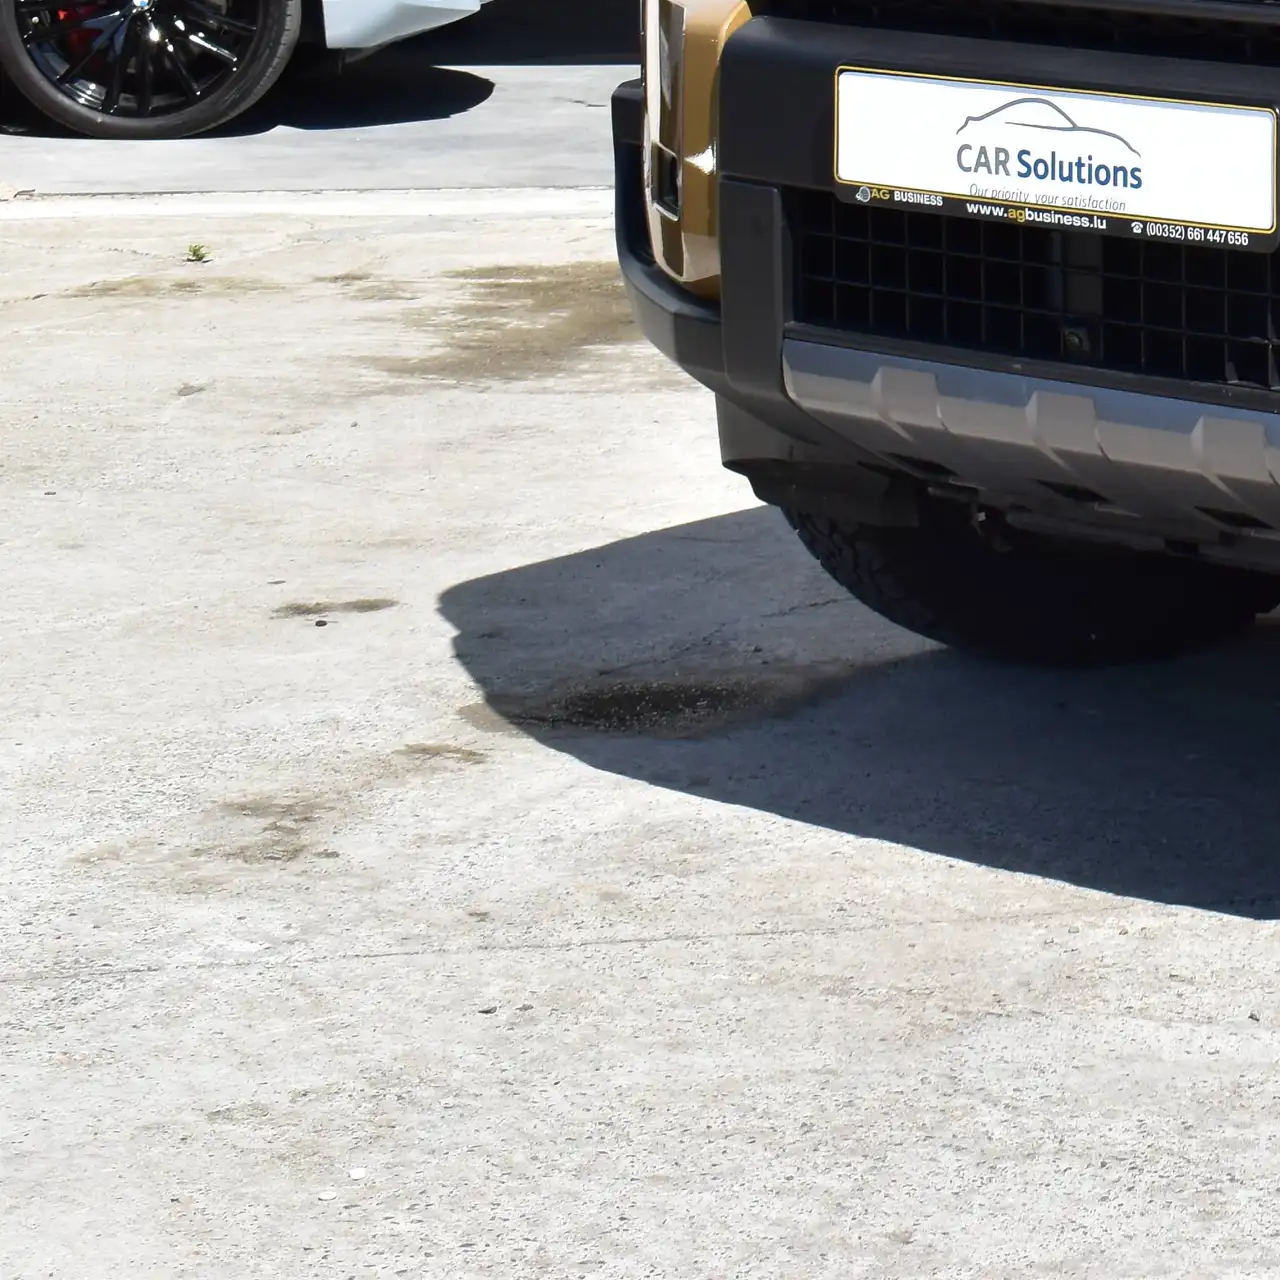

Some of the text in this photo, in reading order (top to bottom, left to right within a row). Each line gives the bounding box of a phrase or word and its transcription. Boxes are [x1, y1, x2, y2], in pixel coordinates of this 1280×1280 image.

[956, 143, 1142, 189] CAR Solutions
[871, 189, 943, 206] AG BUSINESS
[969, 183, 988, 196] Our
[1034, 194, 1058, 205] your
[1061, 195, 1126, 212] satisfaction
[966, 202, 1107, 229] www.agbusiness.lu
[1146, 222, 1248, 246] (00352) 661 447 656
